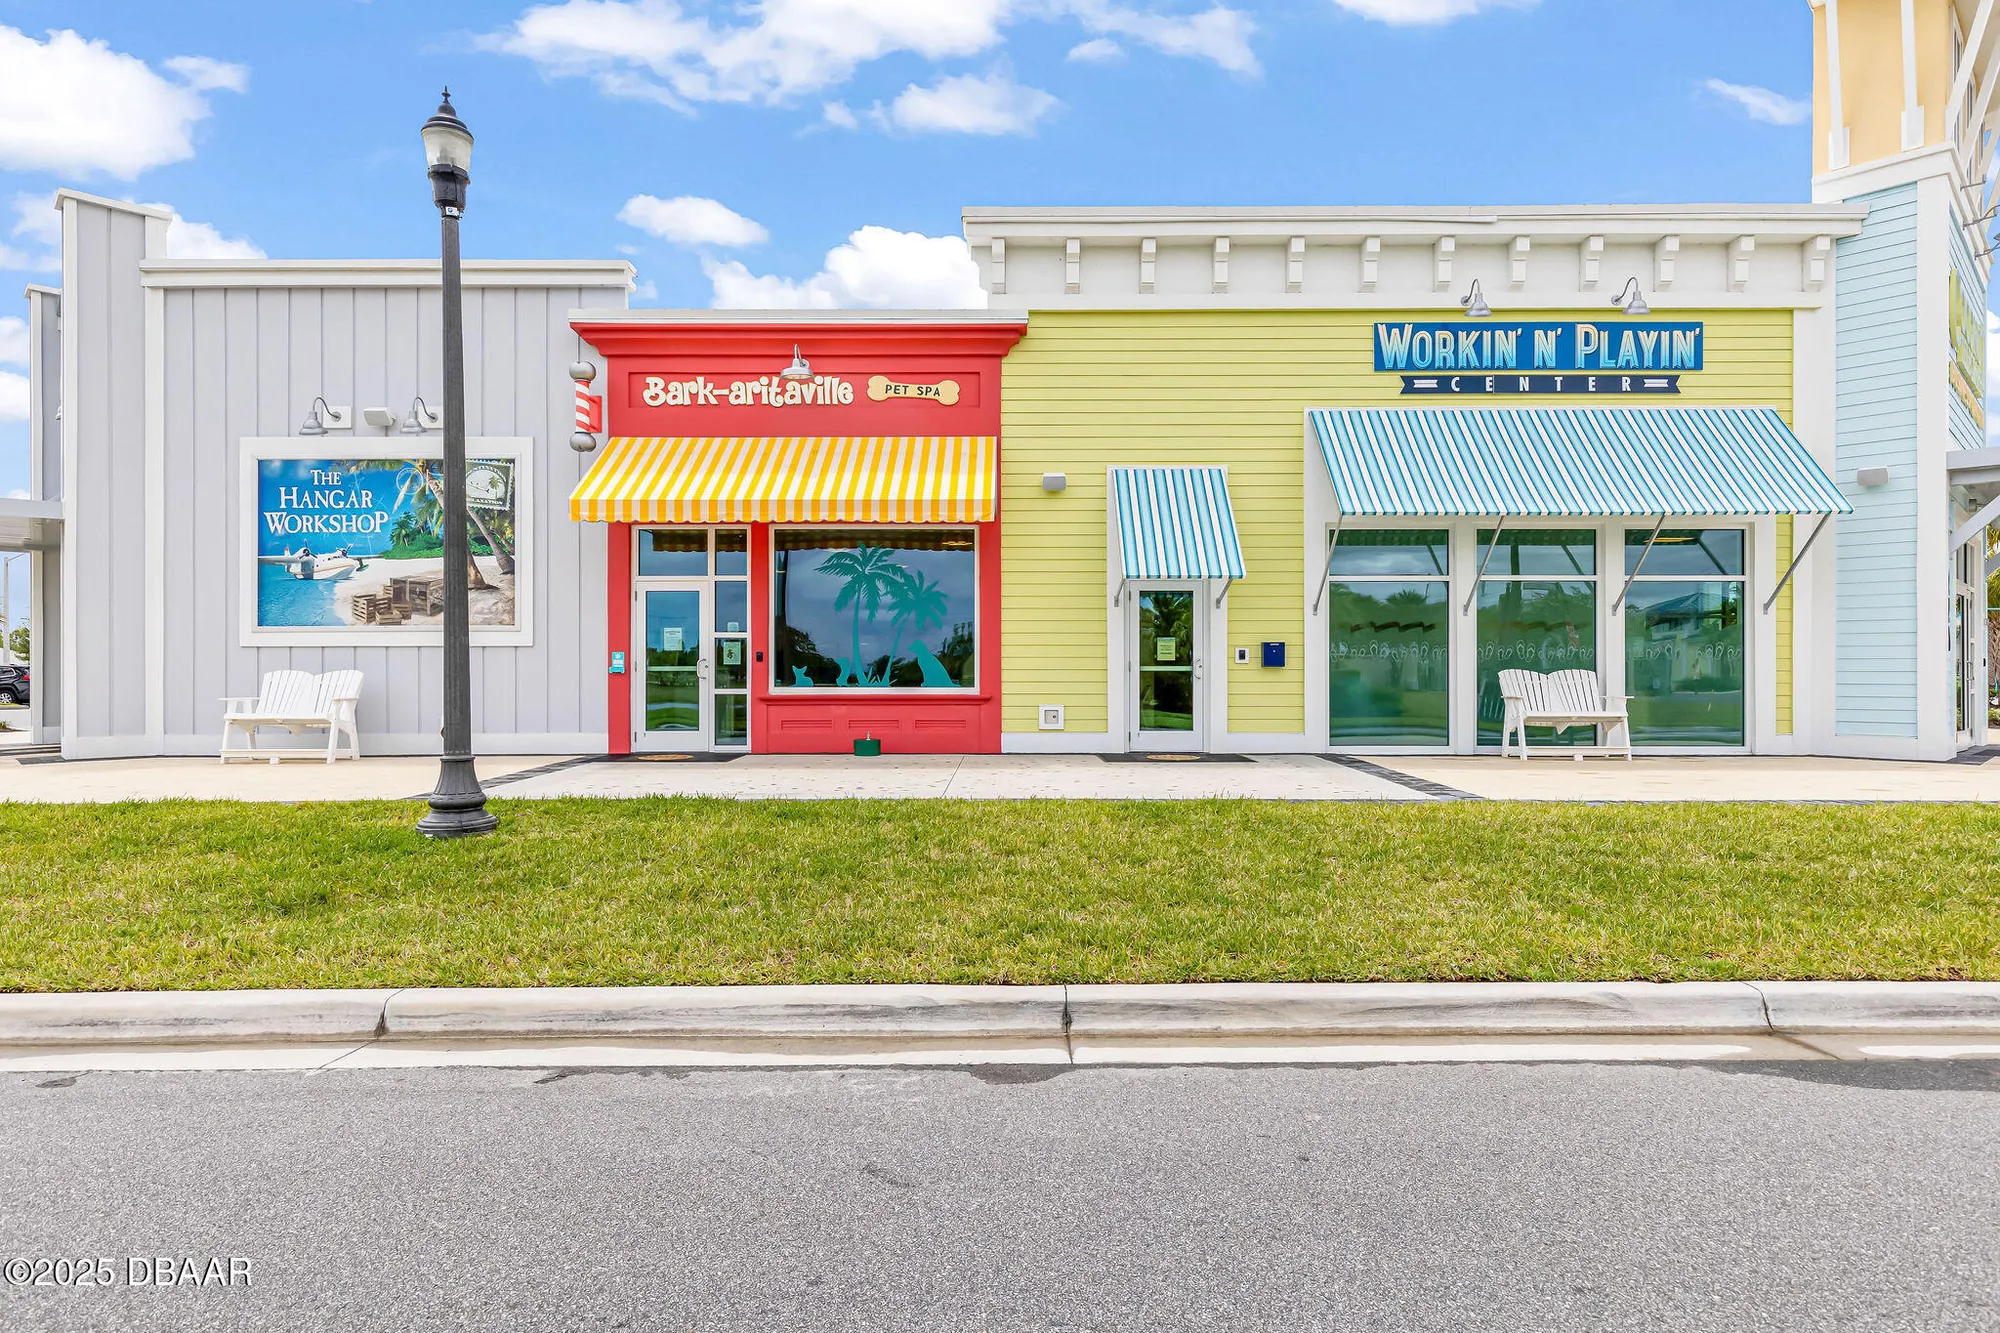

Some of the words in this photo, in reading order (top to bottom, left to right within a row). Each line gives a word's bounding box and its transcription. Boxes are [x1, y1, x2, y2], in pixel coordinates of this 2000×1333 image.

[1377, 323, 1522, 369] WORKIN'
[1574, 323, 1701, 369] PLAYIN'
[642, 376, 854, 407] Bark-aritaville
[884, 384, 909, 395] PET
[917, 386, 941, 397] SPA
[1451, 376, 1632, 392] CENTER
[310, 469, 342, 485] THE
[279, 486, 373, 508] HANGAR
[263, 511, 389, 533] WORKSHOP
